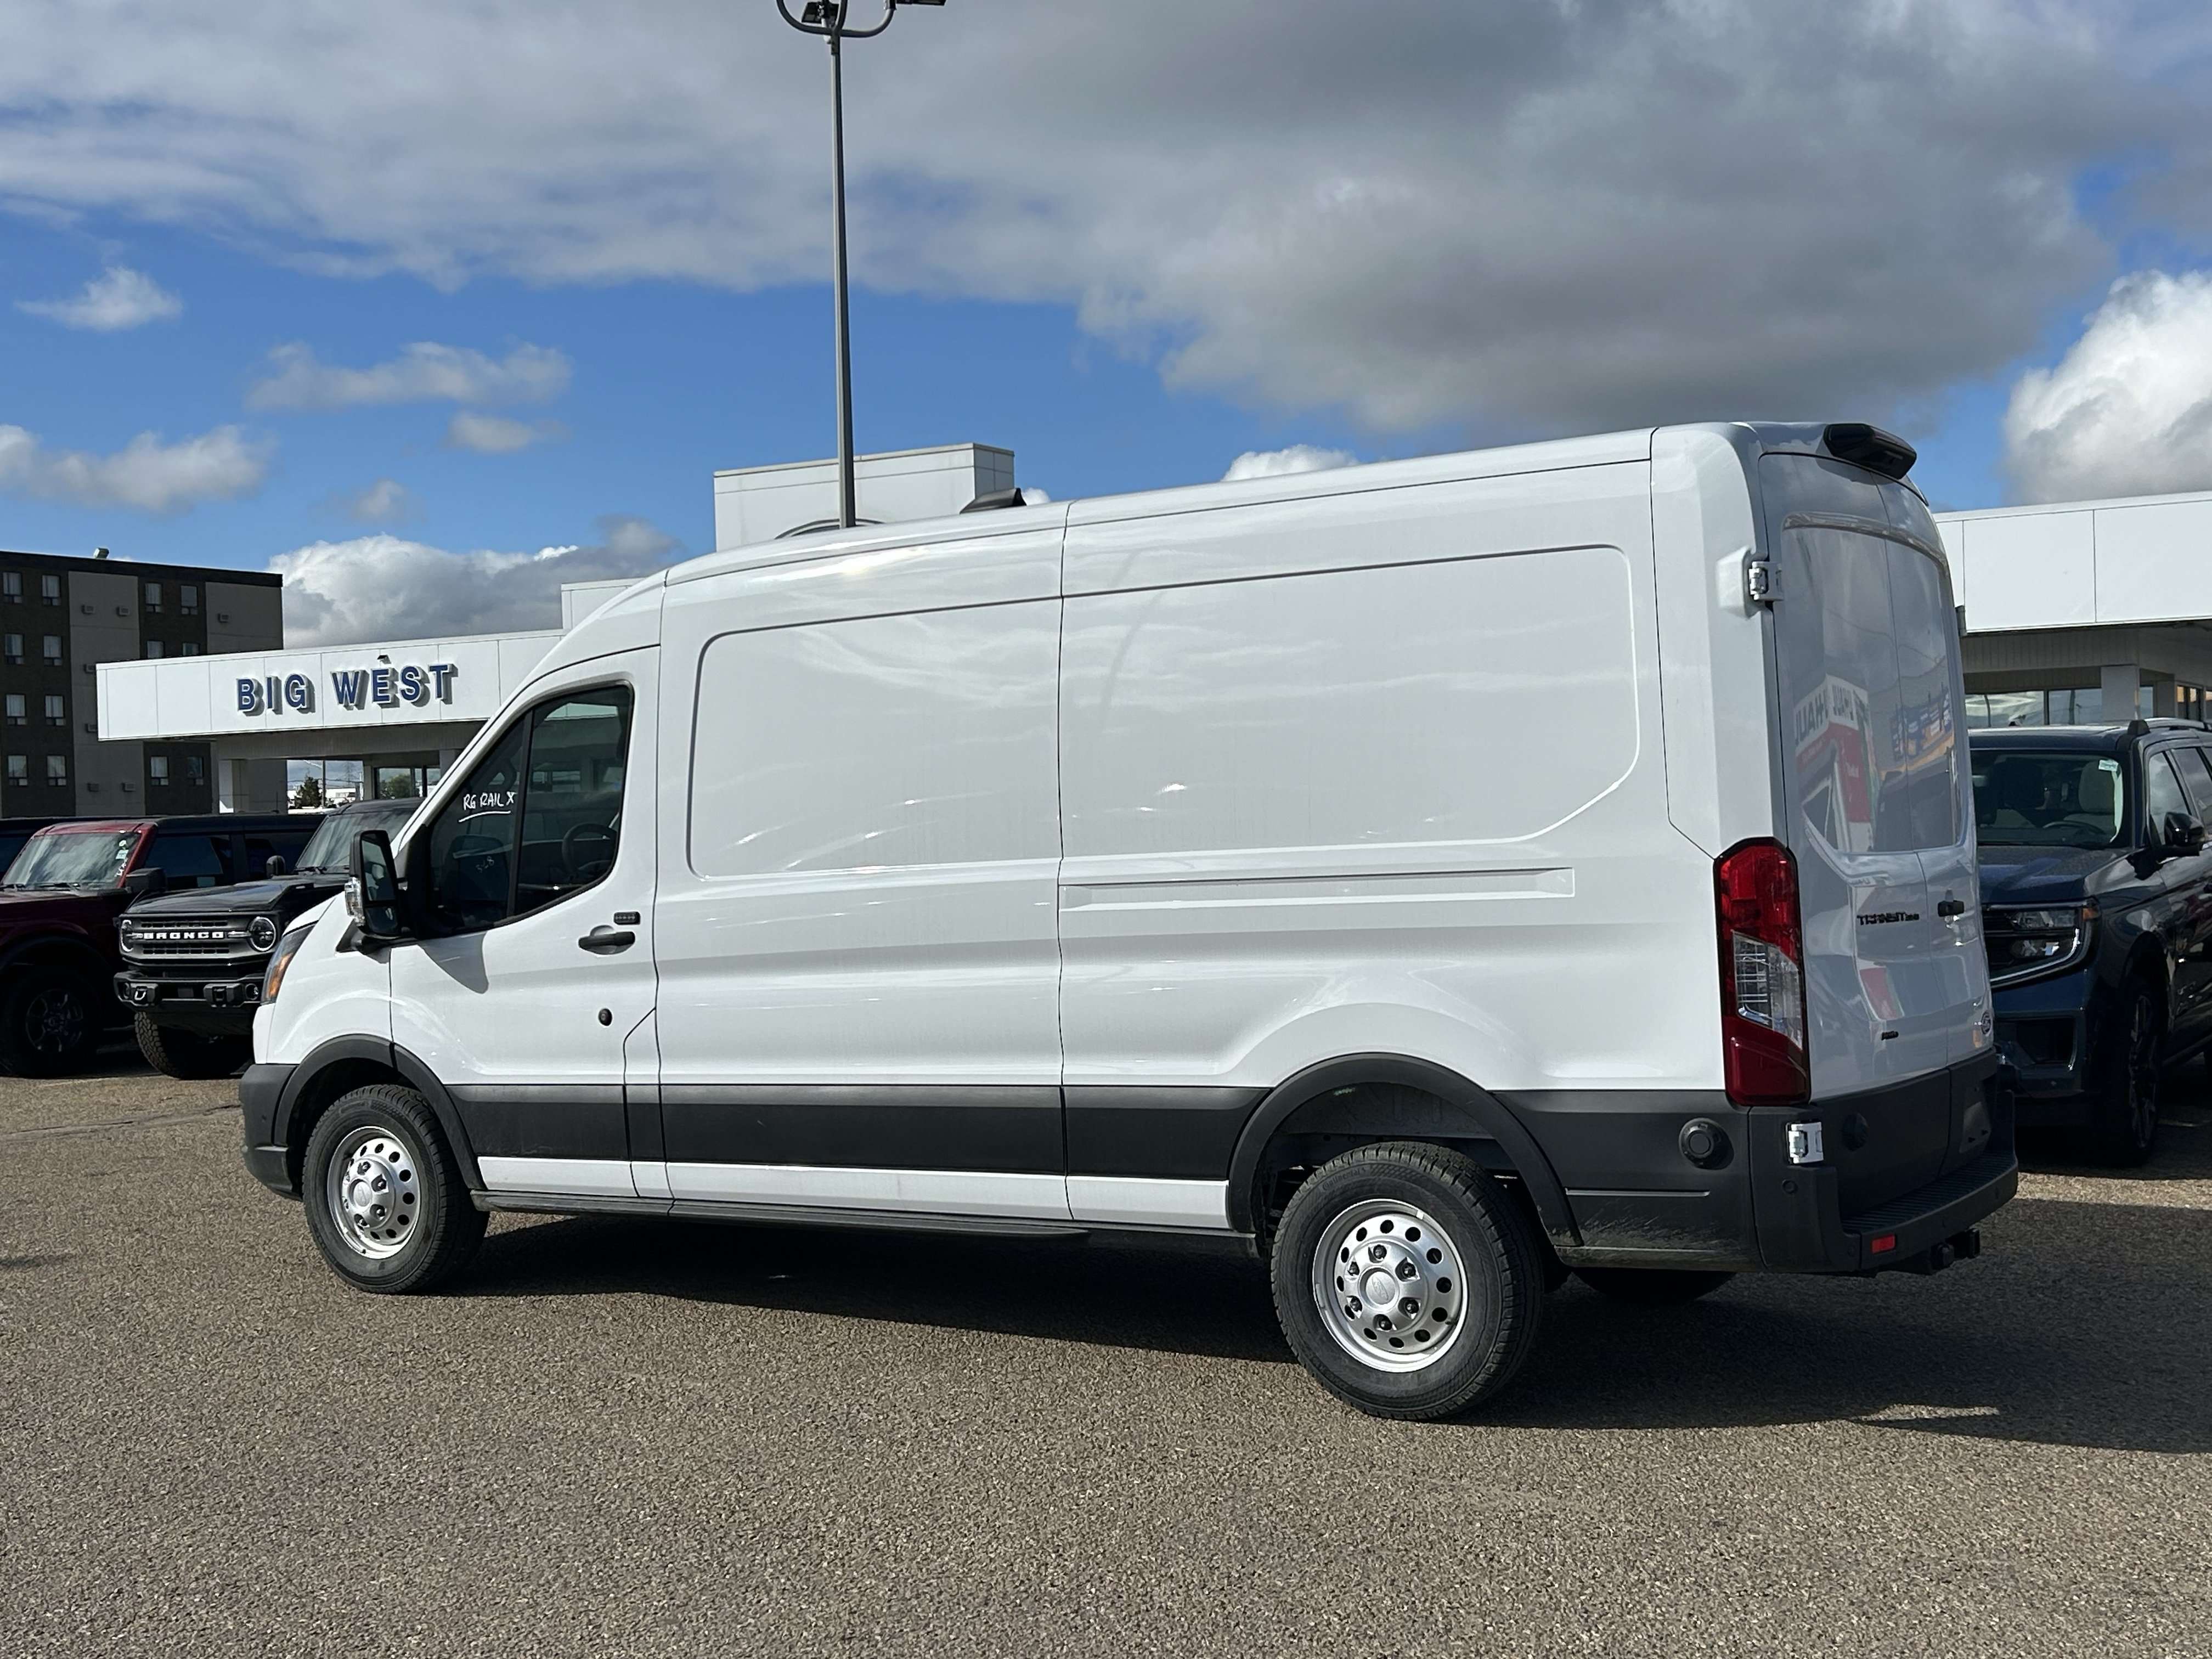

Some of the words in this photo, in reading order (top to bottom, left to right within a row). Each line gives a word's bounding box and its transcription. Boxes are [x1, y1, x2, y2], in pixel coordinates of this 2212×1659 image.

[236, 674, 314, 715] BIG
[330, 663, 457, 709] WEST
[480, 792, 504, 807] RAIL
[143, 931, 224, 939] BRONCO
